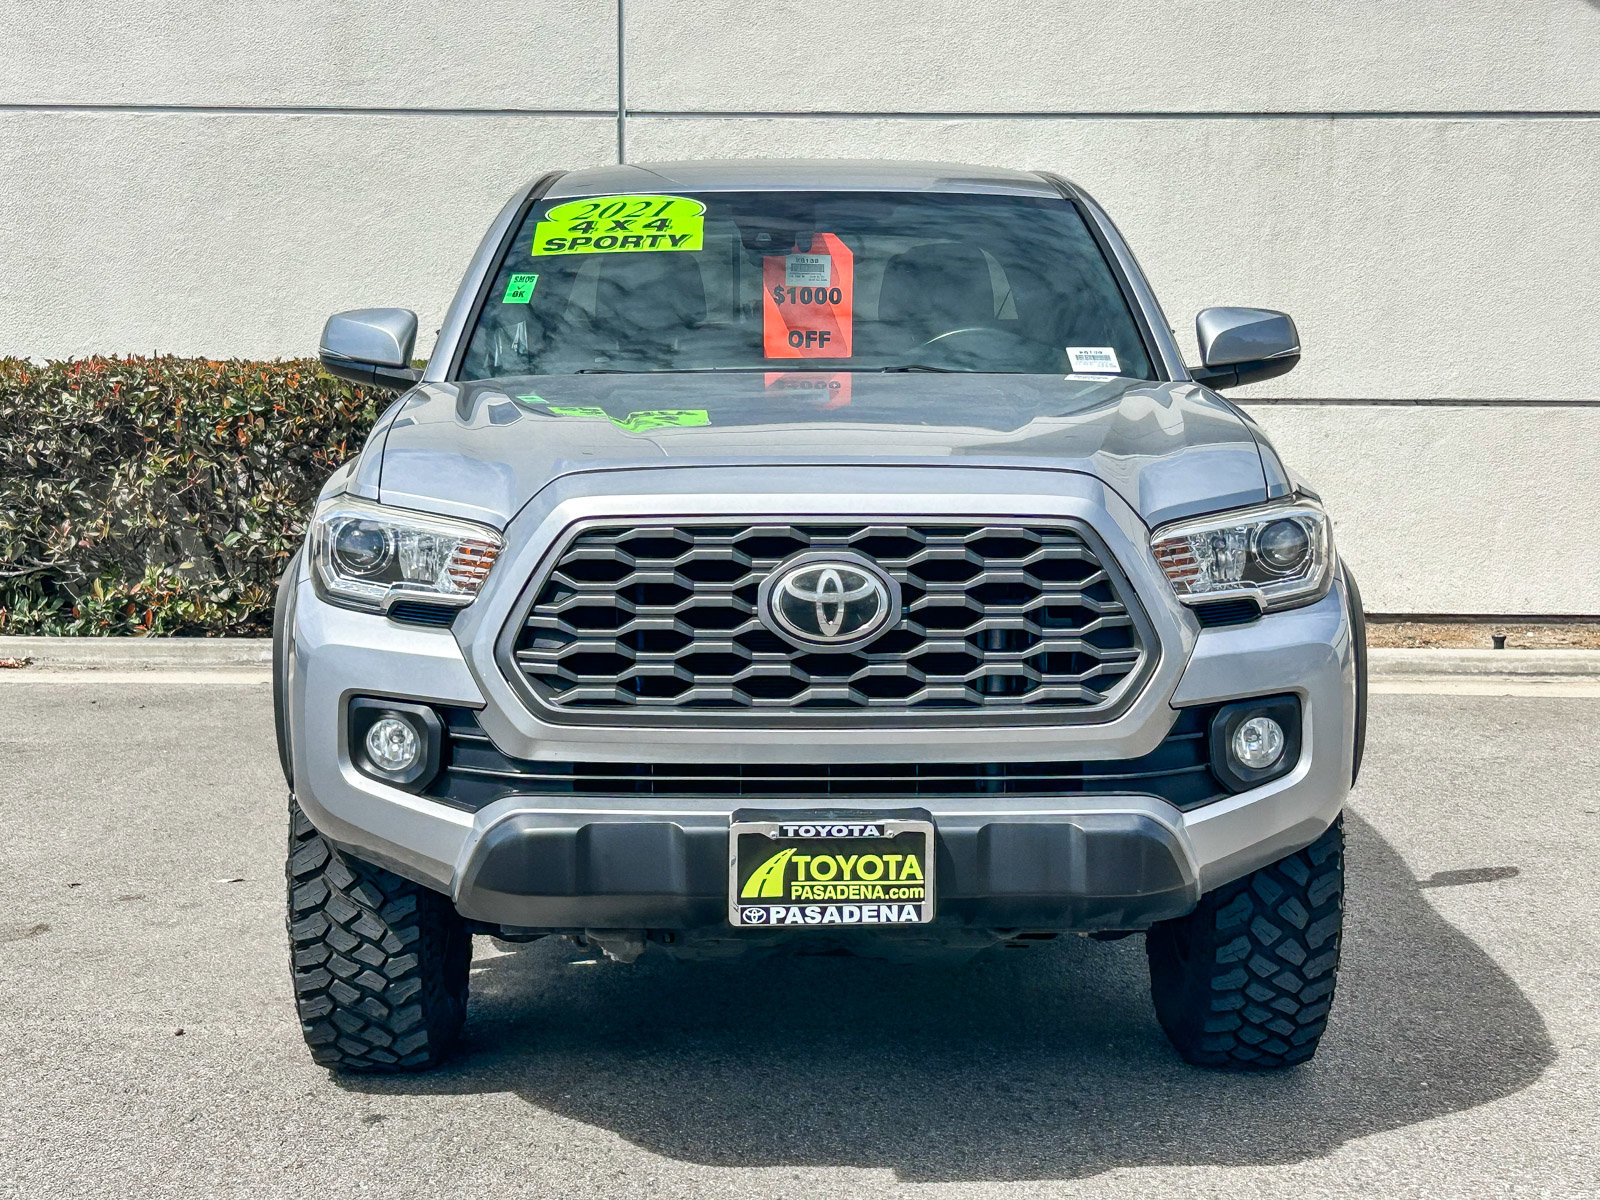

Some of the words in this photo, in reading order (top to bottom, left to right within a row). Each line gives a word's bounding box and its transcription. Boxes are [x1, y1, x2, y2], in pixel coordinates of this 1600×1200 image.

[570, 200, 676, 221] 2021
[542, 233, 693, 252] SPORTY
[511, 290, 526, 298] OK
[773, 284, 843, 306] $1000
[788, 330, 831, 349] OFF
[783, 825, 880, 837] TOYOTA
[791, 854, 924, 881] TOYOTA
[791, 885, 925, 900] PASADENA.com
[769, 904, 920, 925] PASADENA
